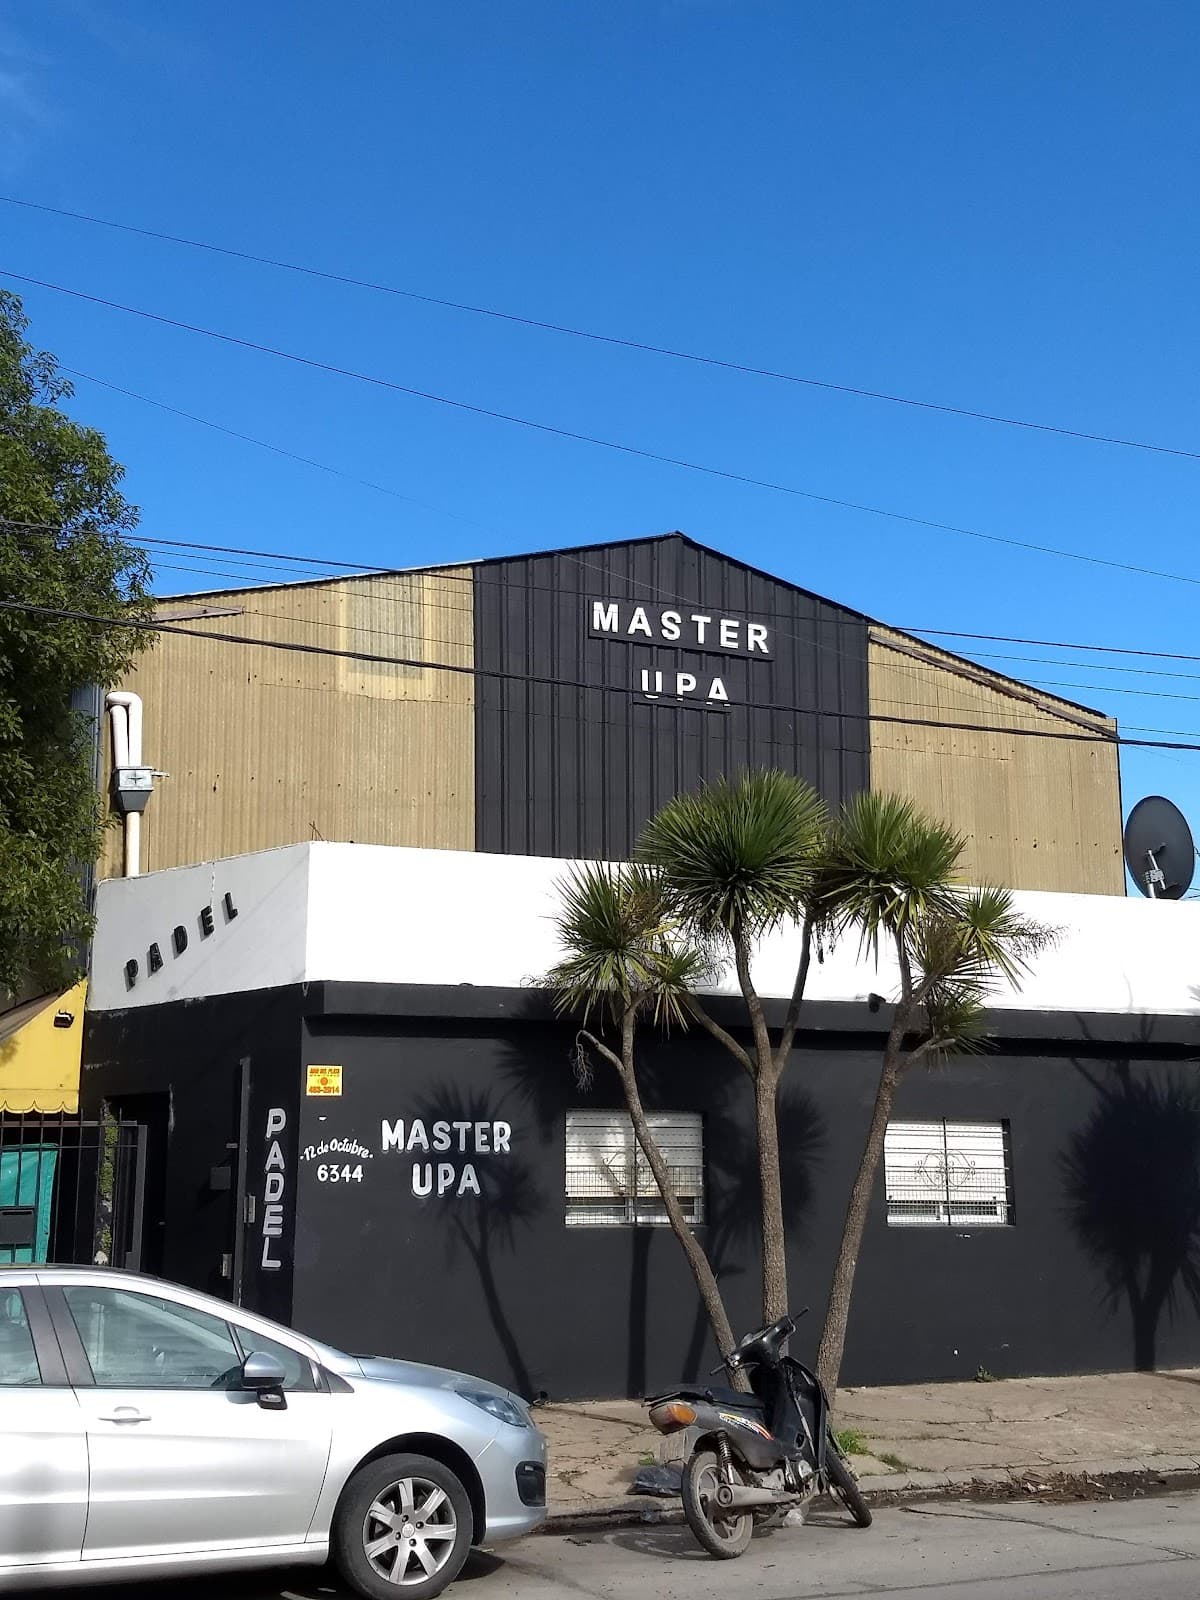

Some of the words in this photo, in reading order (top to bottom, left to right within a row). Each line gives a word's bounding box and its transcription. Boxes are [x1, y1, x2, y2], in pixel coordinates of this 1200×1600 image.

[592, 601, 769, 654] MASTER
[640, 669, 731, 706] UPA
[125, 891, 239, 989] PADEL
[316, 1140, 329, 1155] de
[381, 1118, 512, 1153] MASTER
[261, 1107, 287, 1269] PADEL
[317, 1163, 364, 1183] 6344
[412, 1162, 481, 1196] UPA
